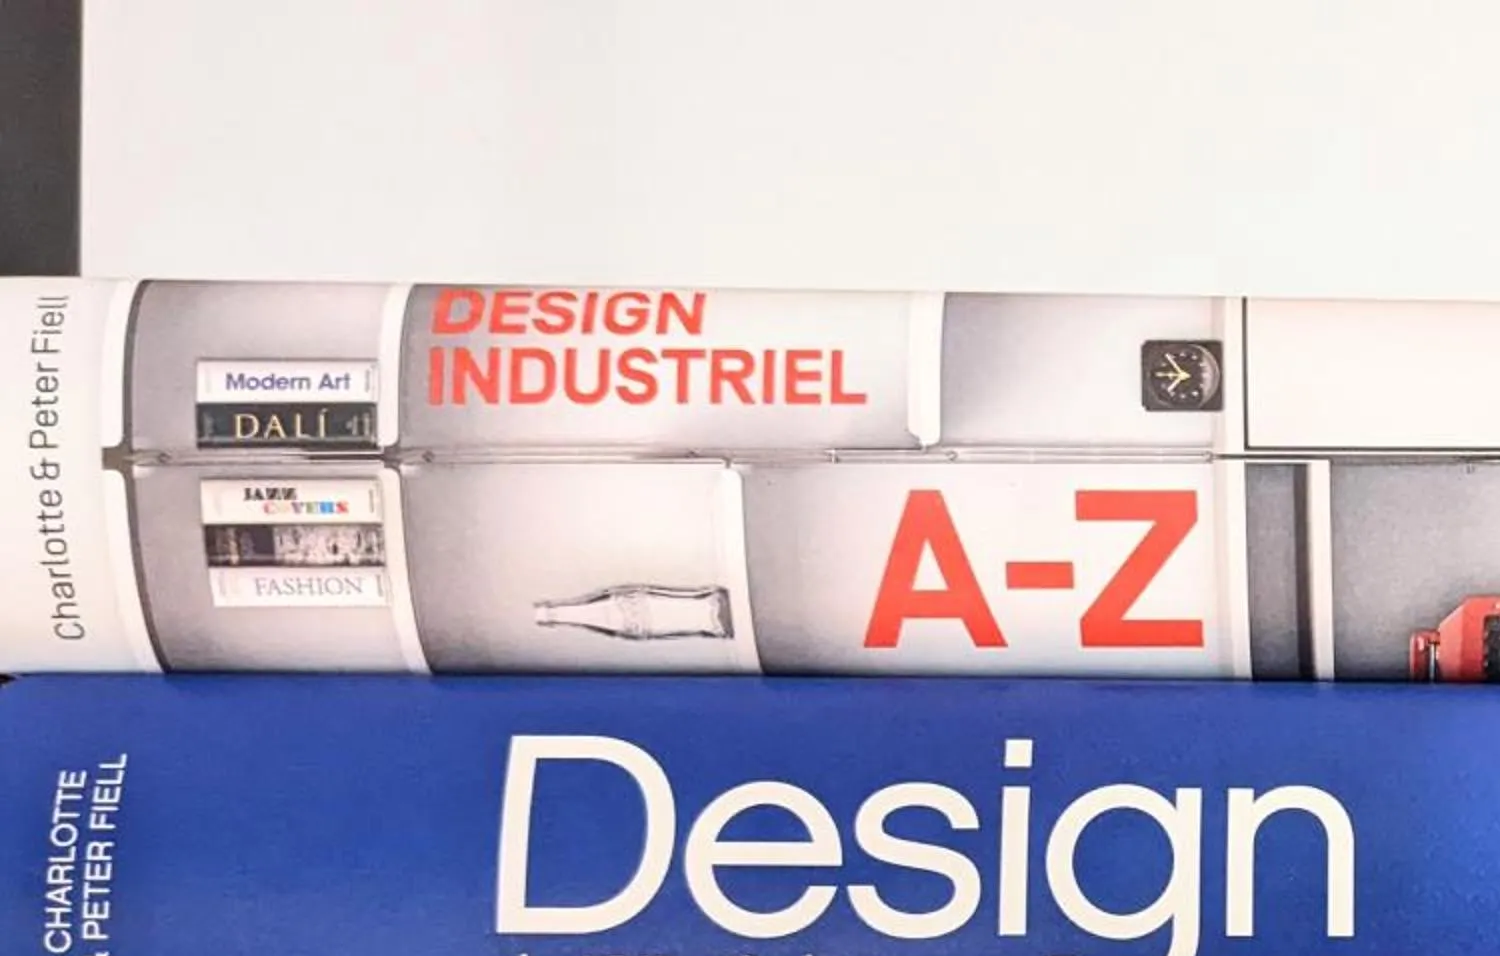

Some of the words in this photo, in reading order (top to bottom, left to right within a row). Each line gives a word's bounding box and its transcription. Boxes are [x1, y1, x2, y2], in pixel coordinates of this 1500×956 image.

[32, 295, 69, 353] Fiell
[431, 288, 706, 335] DESIGN
[226, 373, 311, 390] Modern
[318, 373, 351, 390] Art
[428, 347, 868, 405] INDUSTRIEL
[30, 363, 60, 459] Peter
[234, 408, 328, 439] DALÍ
[30, 460, 62, 482] &
[37, 489, 86, 641] Charlotte
[254, 577, 366, 596] FASHION
[864, 490, 1205, 648] A-Z
[90, 753, 127, 831] FIELL
[44, 770, 87, 953] CHARLOTTE
[82, 841, 115, 940] PETER
